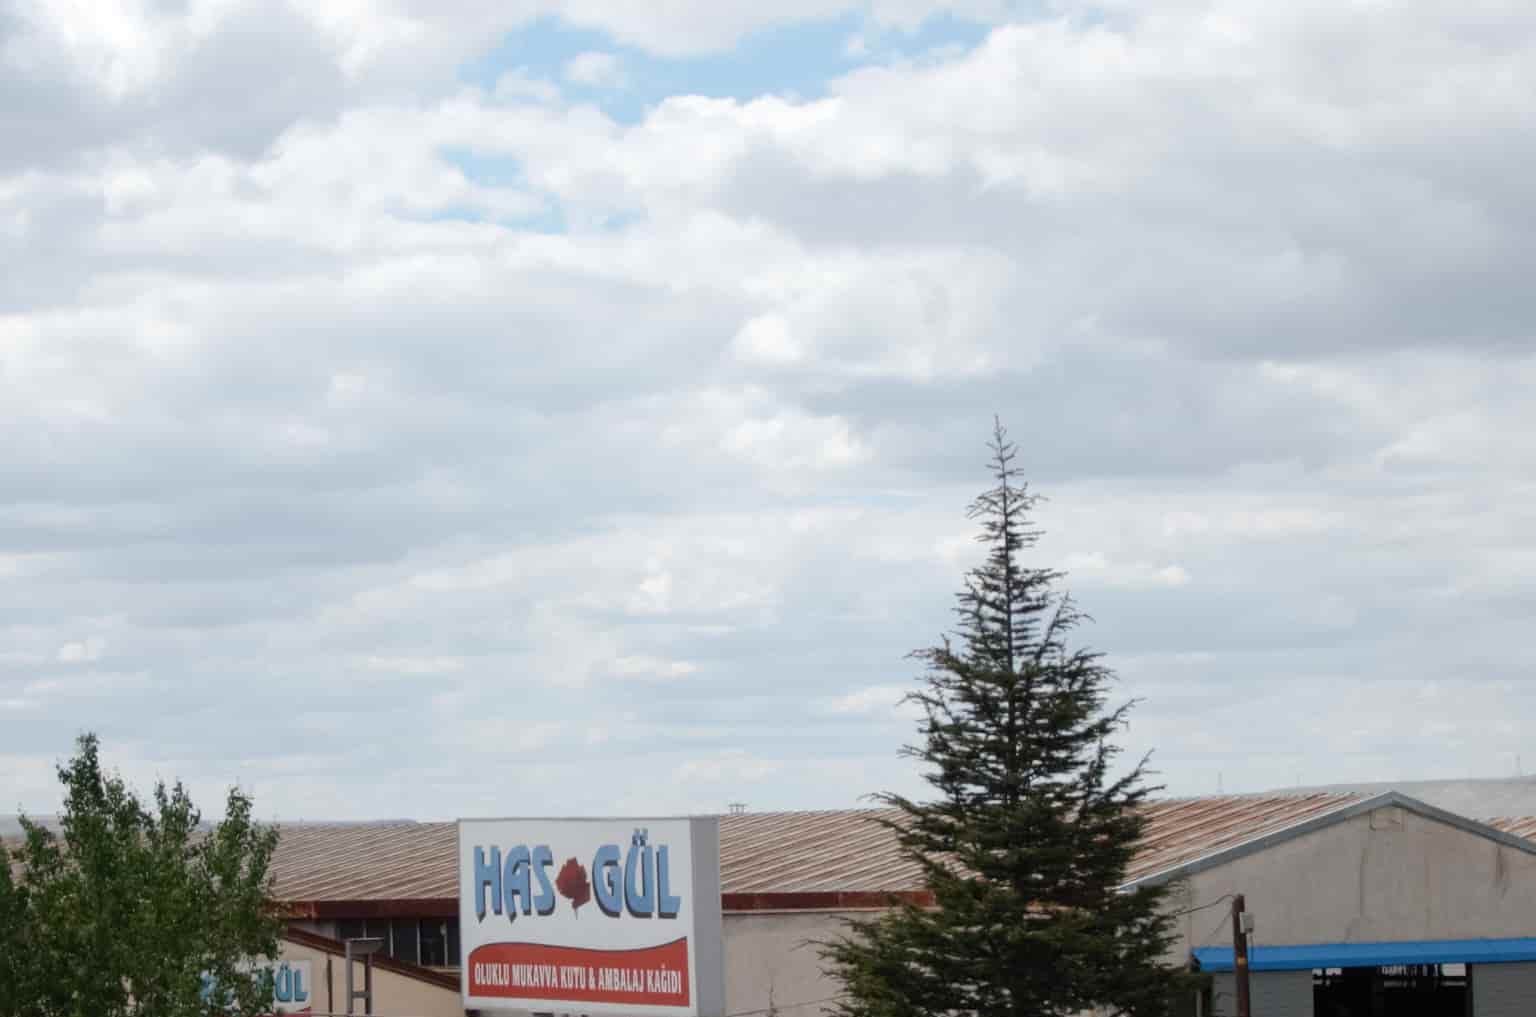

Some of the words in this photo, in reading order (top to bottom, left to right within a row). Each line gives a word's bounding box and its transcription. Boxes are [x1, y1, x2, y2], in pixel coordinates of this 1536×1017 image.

[473, 845, 555, 924] HAS
[592, 828, 681, 919] GÜL
[474, 963, 509, 986] OLUKLU
[512, 964, 558, 988] MUKAVVA
[560, 966, 586, 990] KUTU
[588, 967, 596, 990] &
[597, 968, 644, 993] AMBALAJ
